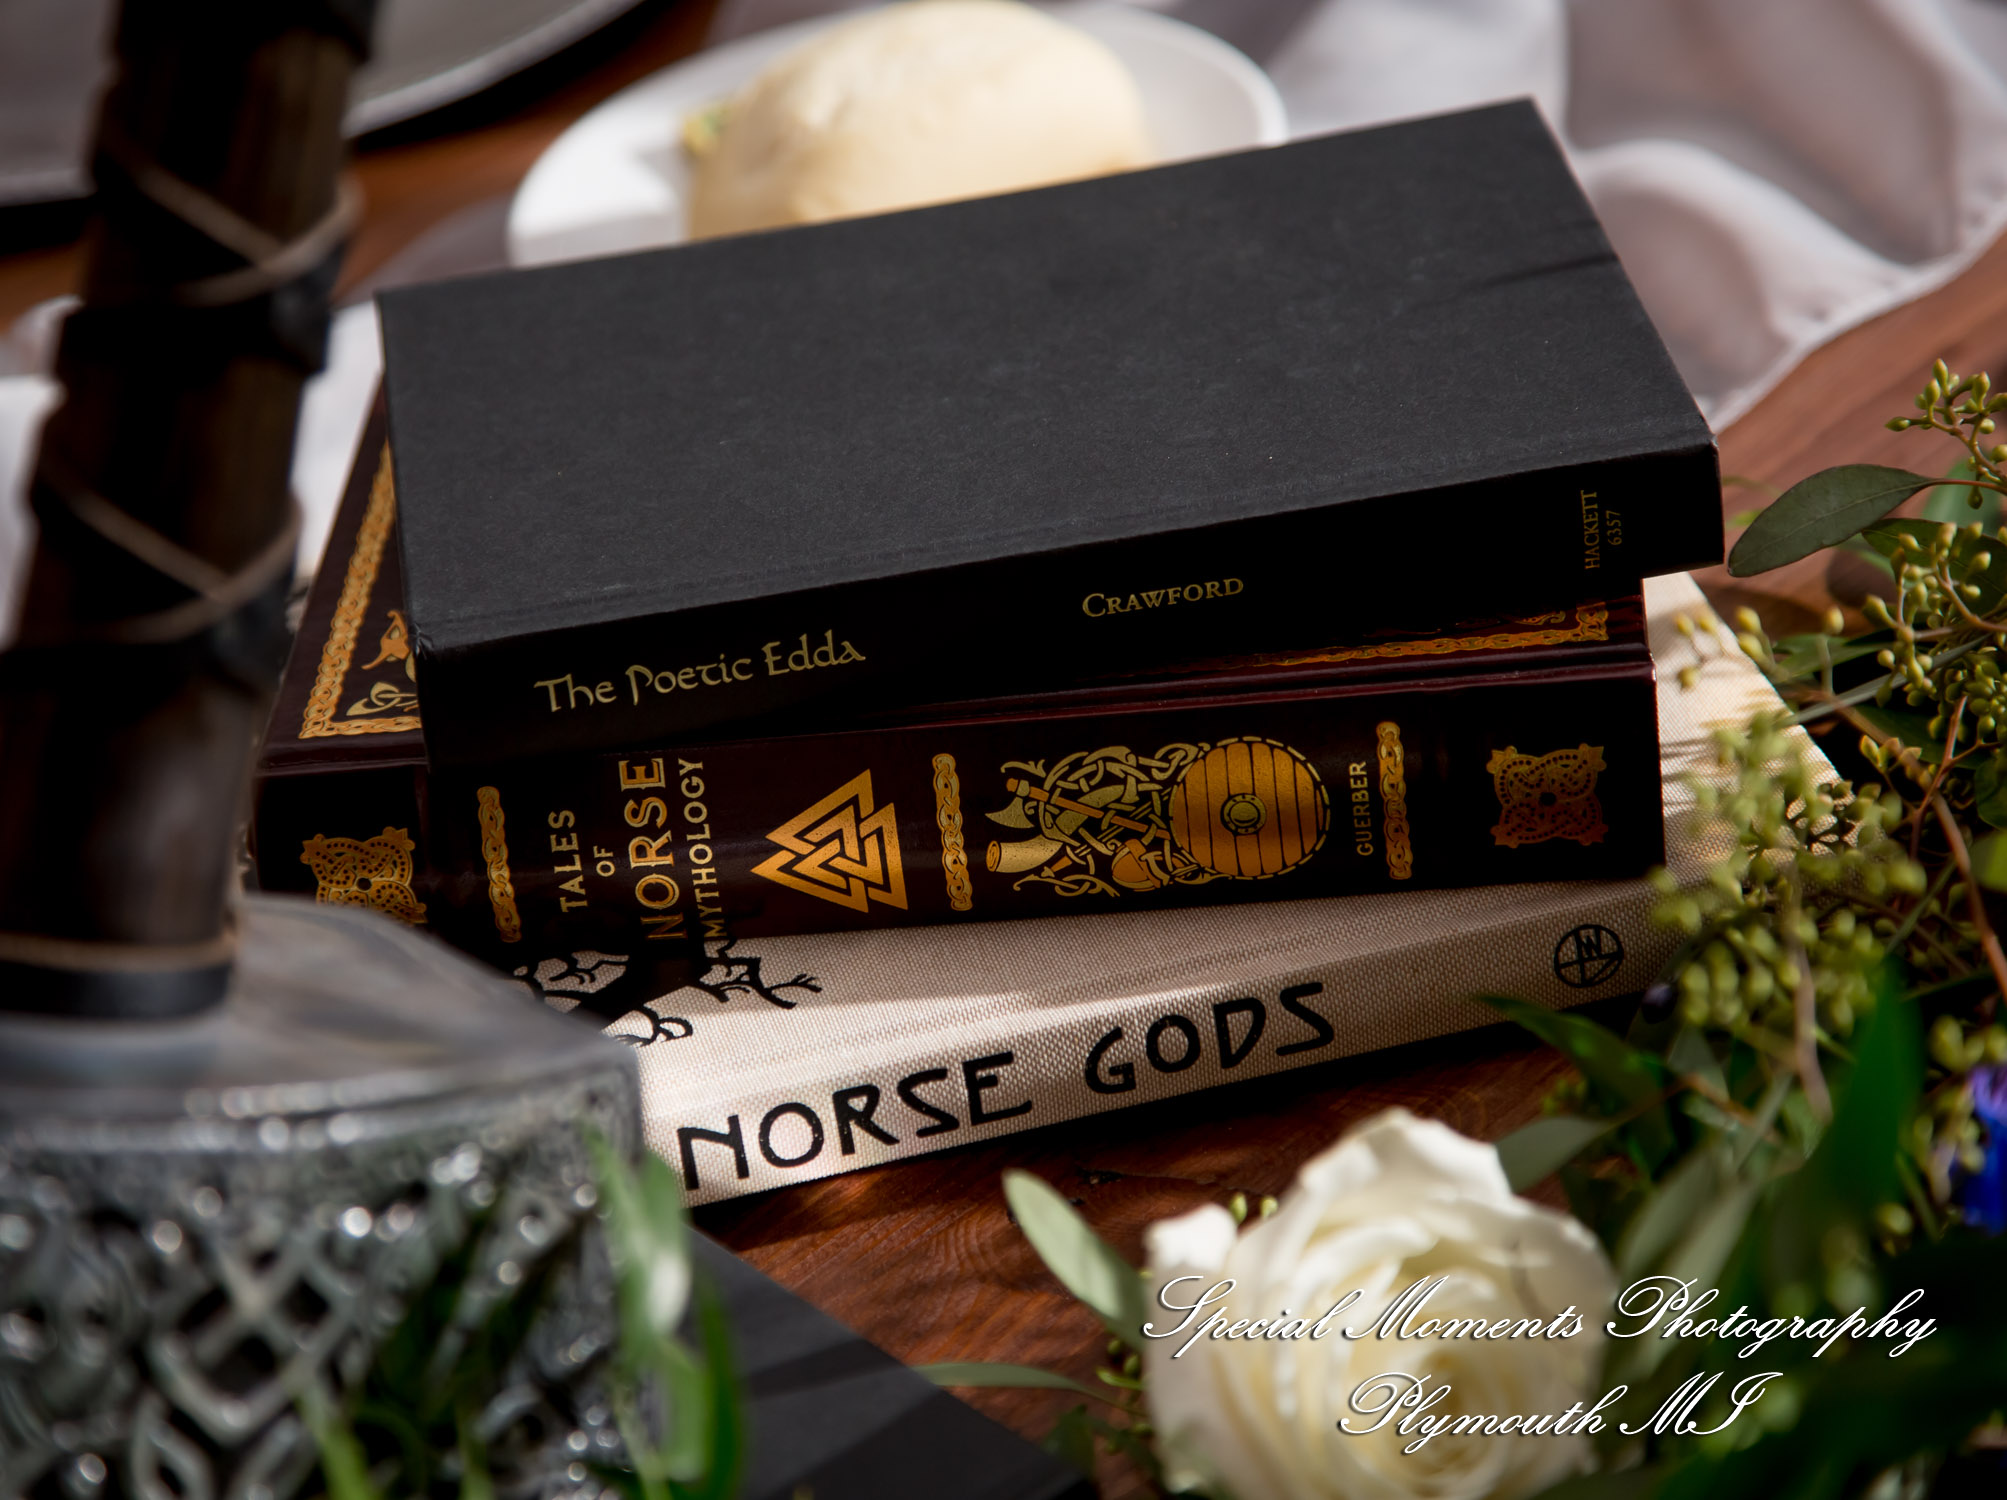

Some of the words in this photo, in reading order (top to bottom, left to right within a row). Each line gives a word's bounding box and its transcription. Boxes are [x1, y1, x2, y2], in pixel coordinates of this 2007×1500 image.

[1580, 490, 1600, 569] HACKETT
[1606, 510, 1622, 545] 6357
[533, 673, 617, 712] The
[625, 653, 752, 706] Poetic
[761, 629, 866, 676] Edda
[618, 757, 688, 940] NORSE
[678, 757, 727, 937] MYTHOLOGY
[1349, 761, 1374, 856] GUERBER
[548, 809, 588, 912] TALES
[593, 845, 615, 877] OF
[677, 1052, 1033, 1190] NORSE
[1085, 981, 1335, 1095] GODS
